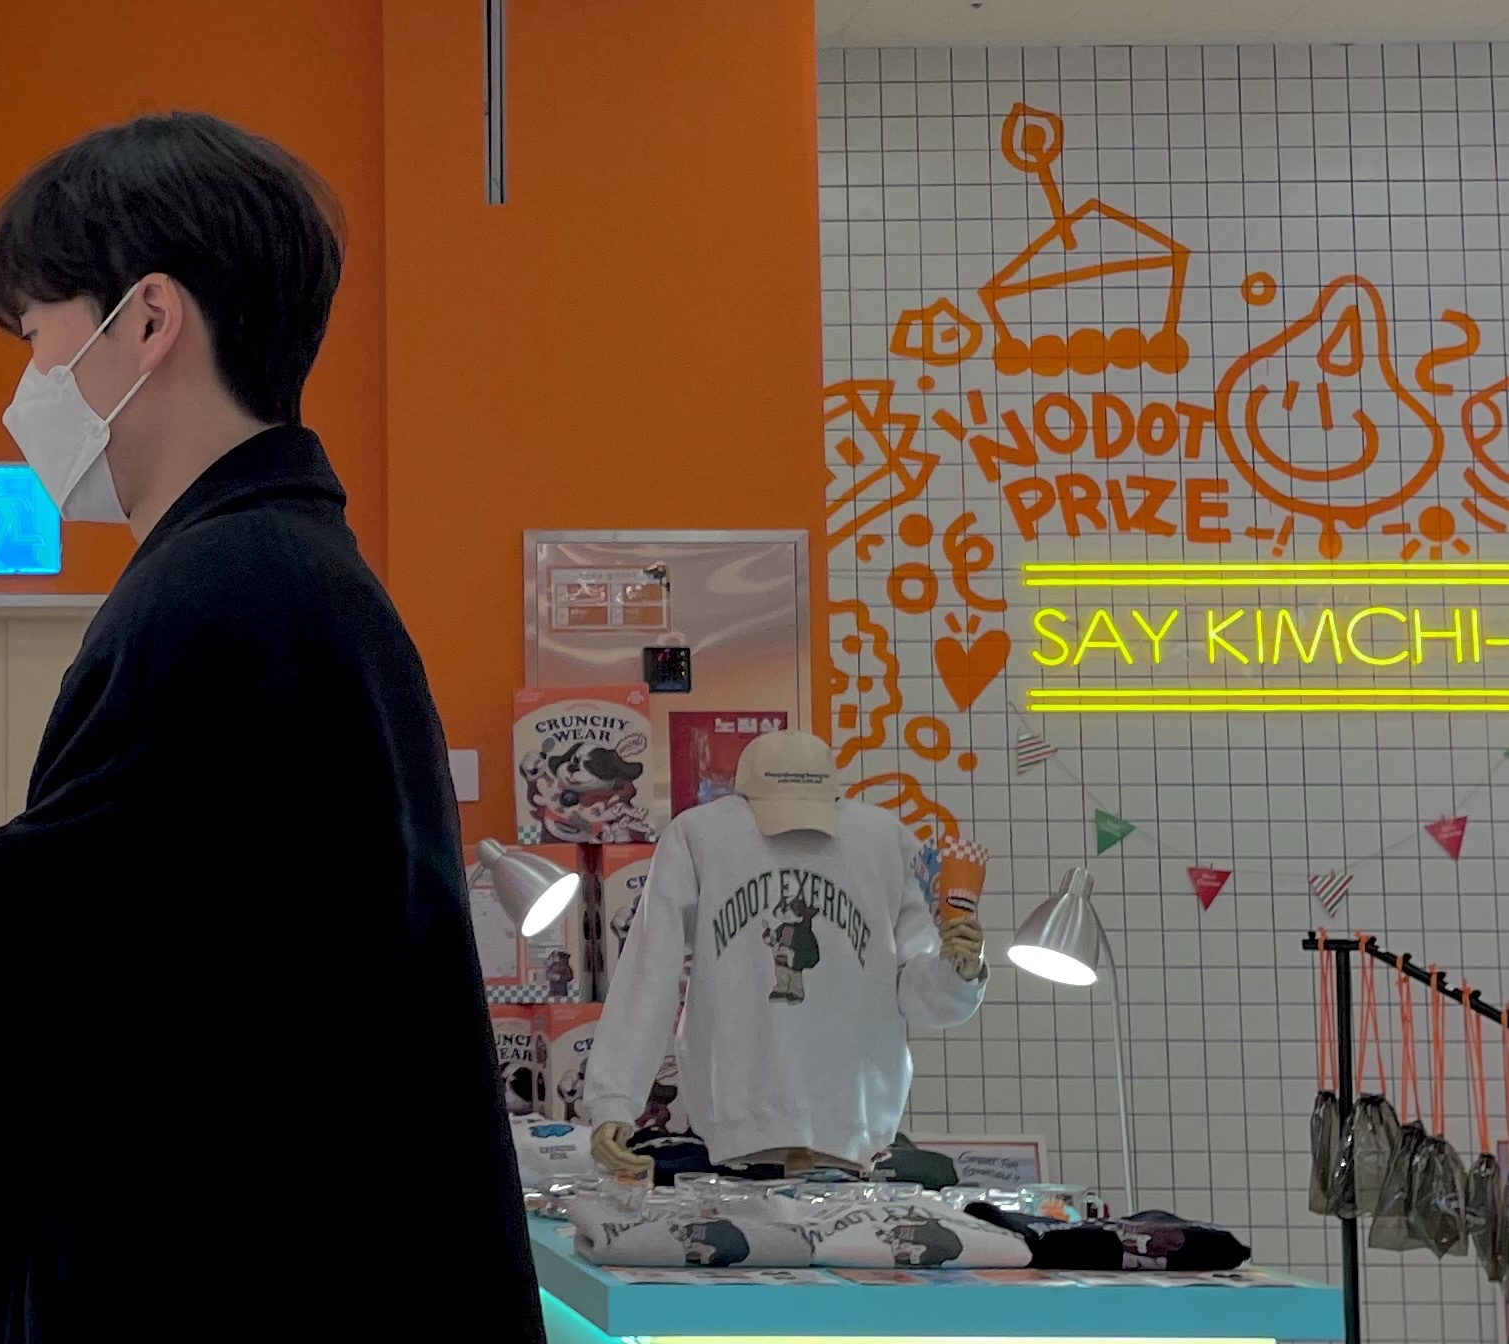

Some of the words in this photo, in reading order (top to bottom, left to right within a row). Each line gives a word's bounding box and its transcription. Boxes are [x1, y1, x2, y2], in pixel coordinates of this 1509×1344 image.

[970, 392, 1218, 481] NODOT
[1002, 475, 1232, 543] PRIZE
[1032, 607, 1178, 667] SAY
[535, 715, 631, 733] CRUNCHY
[552, 728, 612, 743] WEAR
[712, 871, 773, 959] NODOT
[777, 869, 871, 970] EXERCISE
